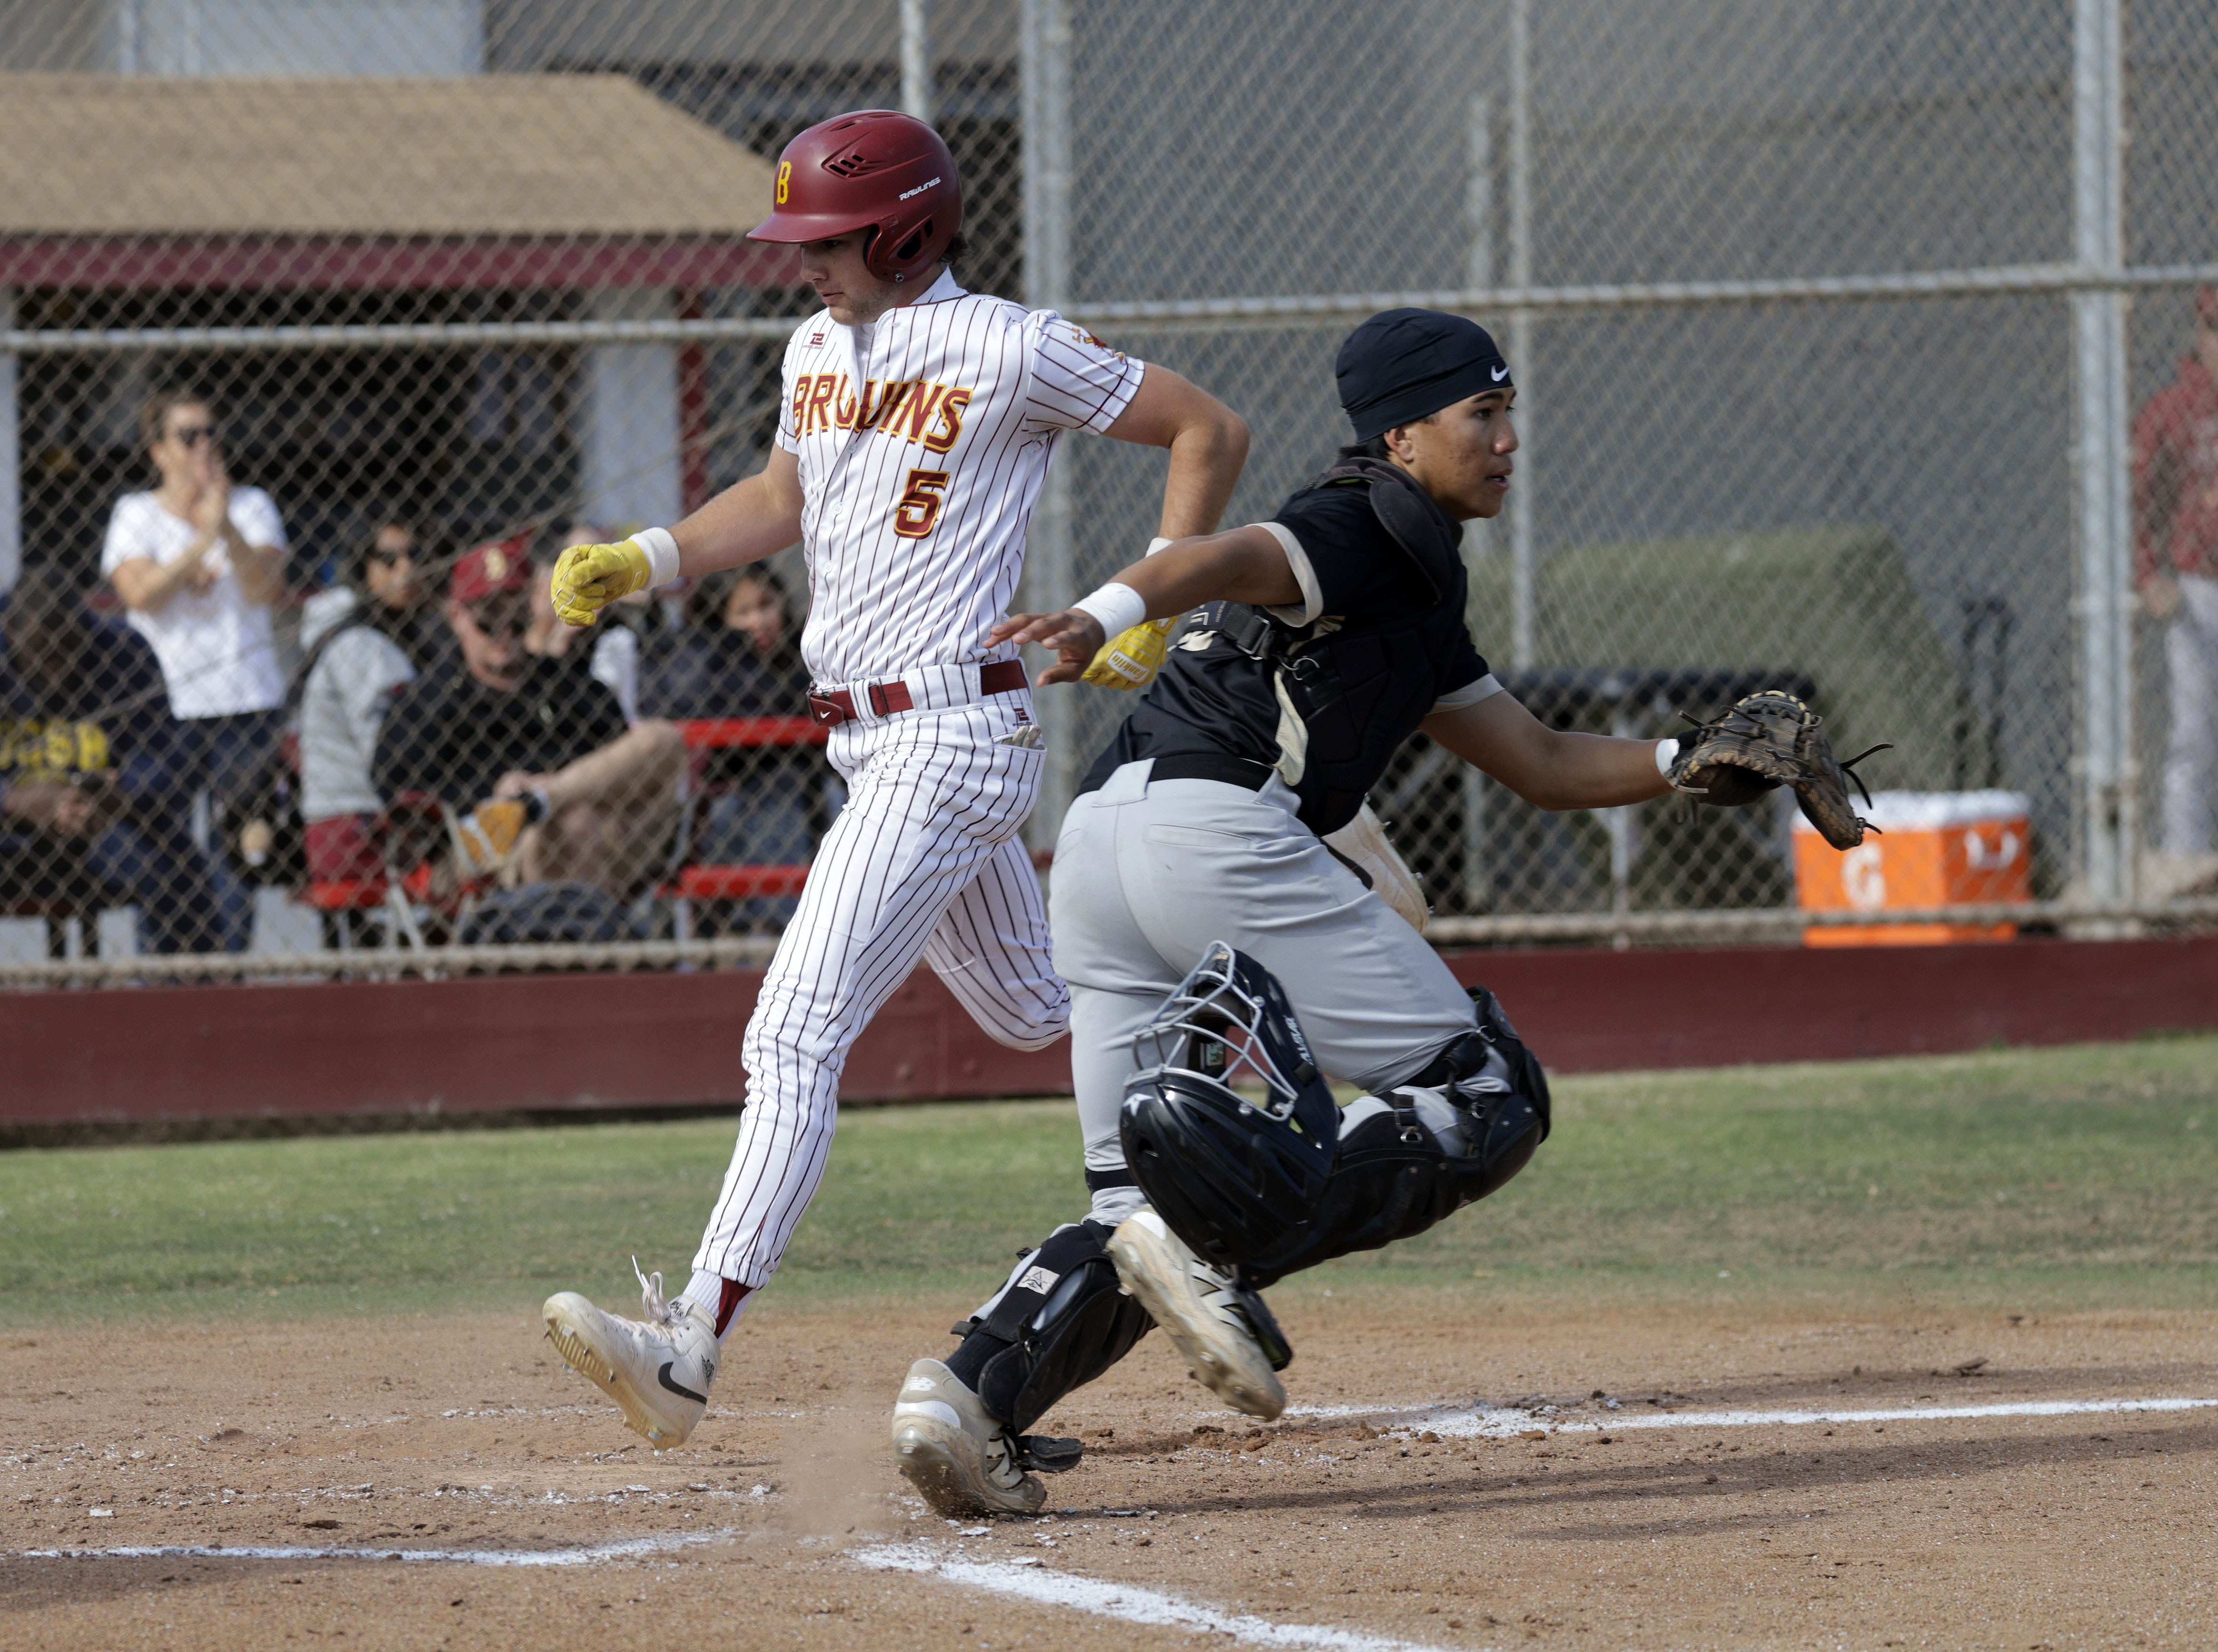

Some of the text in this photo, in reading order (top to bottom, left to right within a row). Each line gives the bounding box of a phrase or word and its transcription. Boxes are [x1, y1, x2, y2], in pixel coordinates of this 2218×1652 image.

[776, 161, 792, 204] B
[899, 177, 941, 201] RAWLINGS
[793, 372, 974, 455] BRUINS
[894, 468, 950, 540] 5
